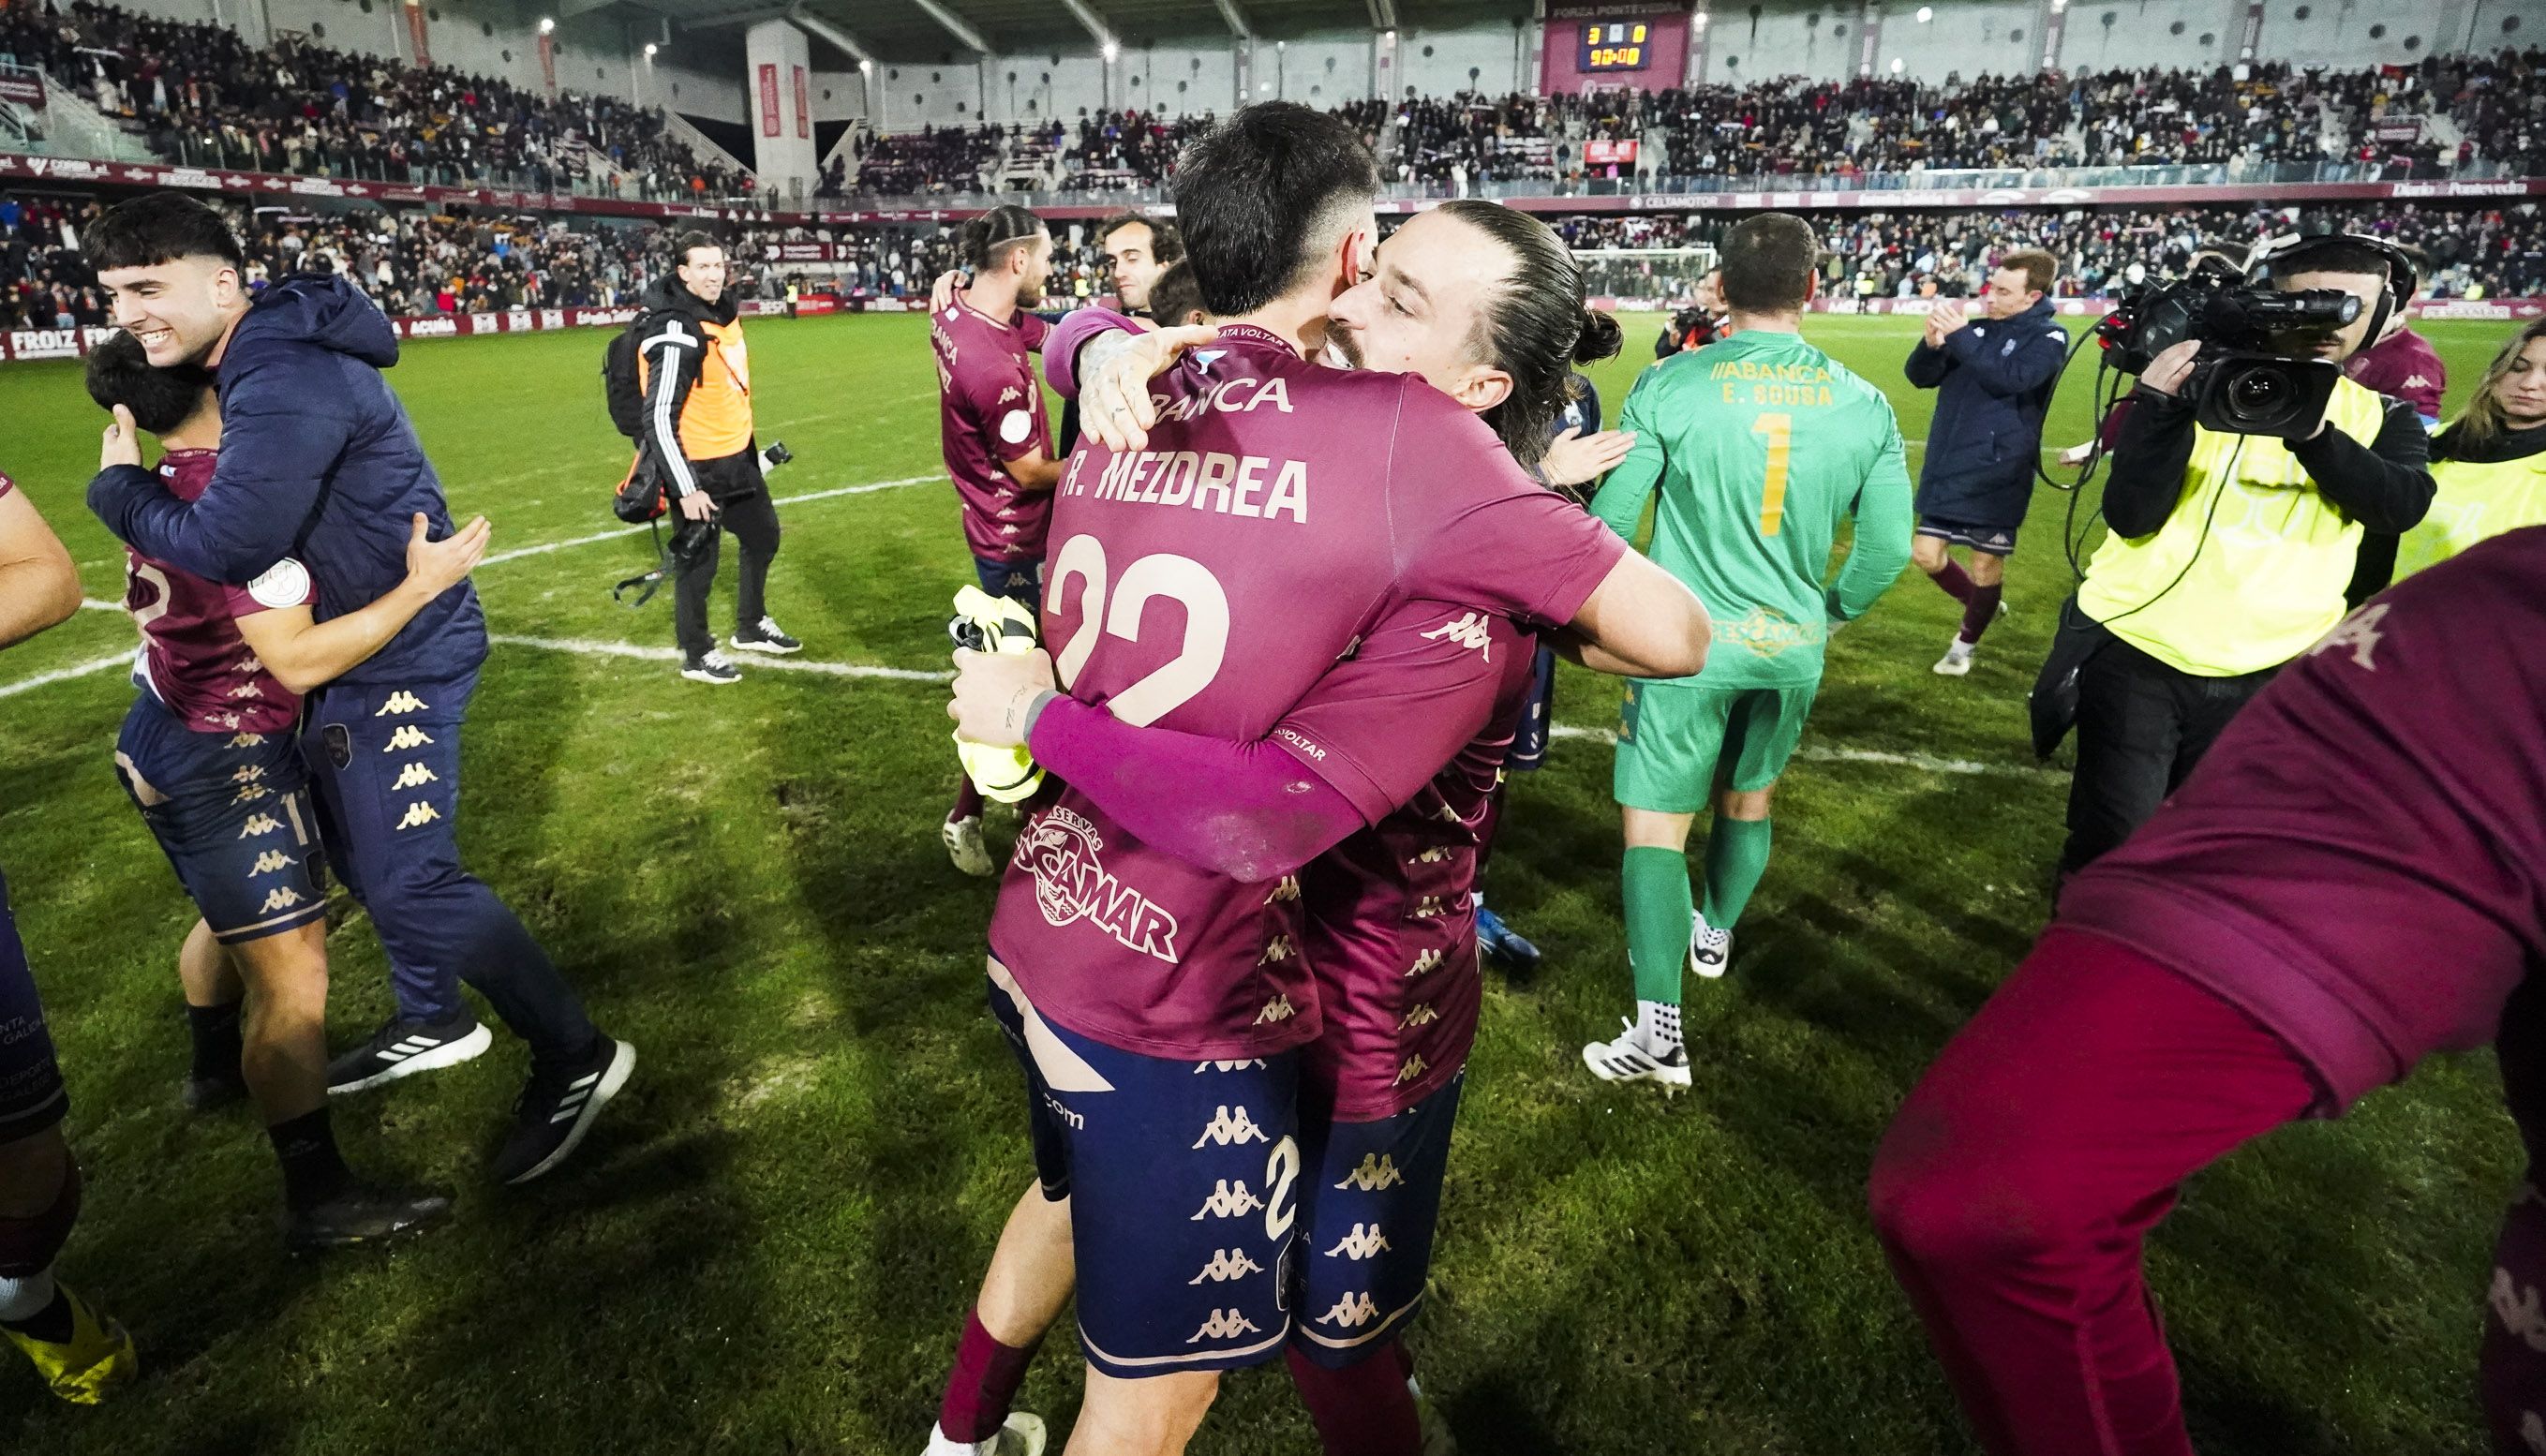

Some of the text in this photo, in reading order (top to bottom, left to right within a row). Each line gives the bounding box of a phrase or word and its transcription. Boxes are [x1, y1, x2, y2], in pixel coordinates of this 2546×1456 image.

[1588, 24, 1646, 45] 3 0
[10, 329, 78, 351] FROIZ
[1241, 327, 1285, 347] VOLTAR
[1151, 377, 1294, 424] BANCA
[1754, 383, 1834, 406] SOUSA
[1062, 450, 1308, 524] R. MEZDREA
[1750, 412, 1792, 537] 1
[1047, 533, 1230, 728] 22
[1266, 1135, 1301, 1241] 2
